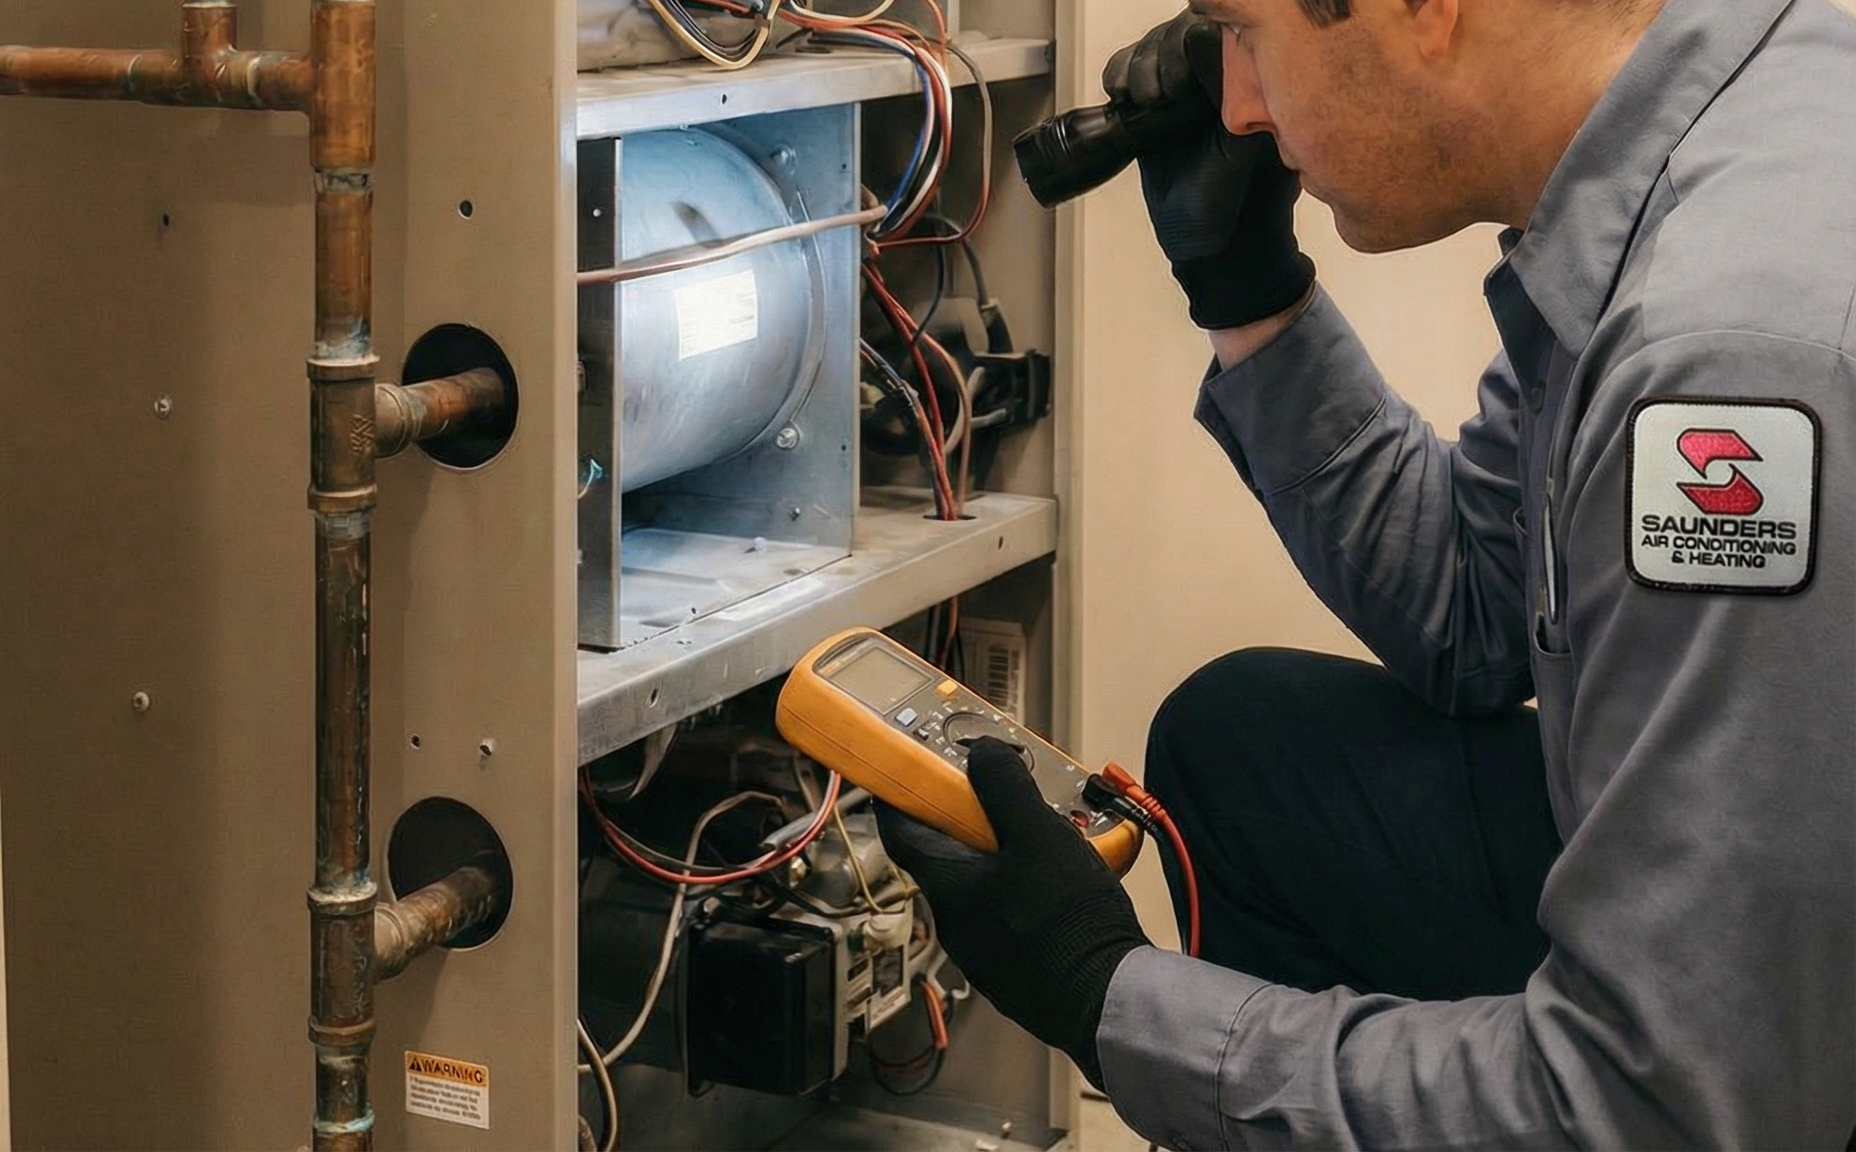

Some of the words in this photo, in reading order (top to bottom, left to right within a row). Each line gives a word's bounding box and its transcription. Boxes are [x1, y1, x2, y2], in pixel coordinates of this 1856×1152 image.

[1641, 514, 1797, 540] SAUNDERS
[1641, 534, 1669, 548] AIR
[1672, 535, 1797, 556] CONDITIONING
[1671, 550, 1685, 564] &
[1689, 551, 1767, 569] HEATING
